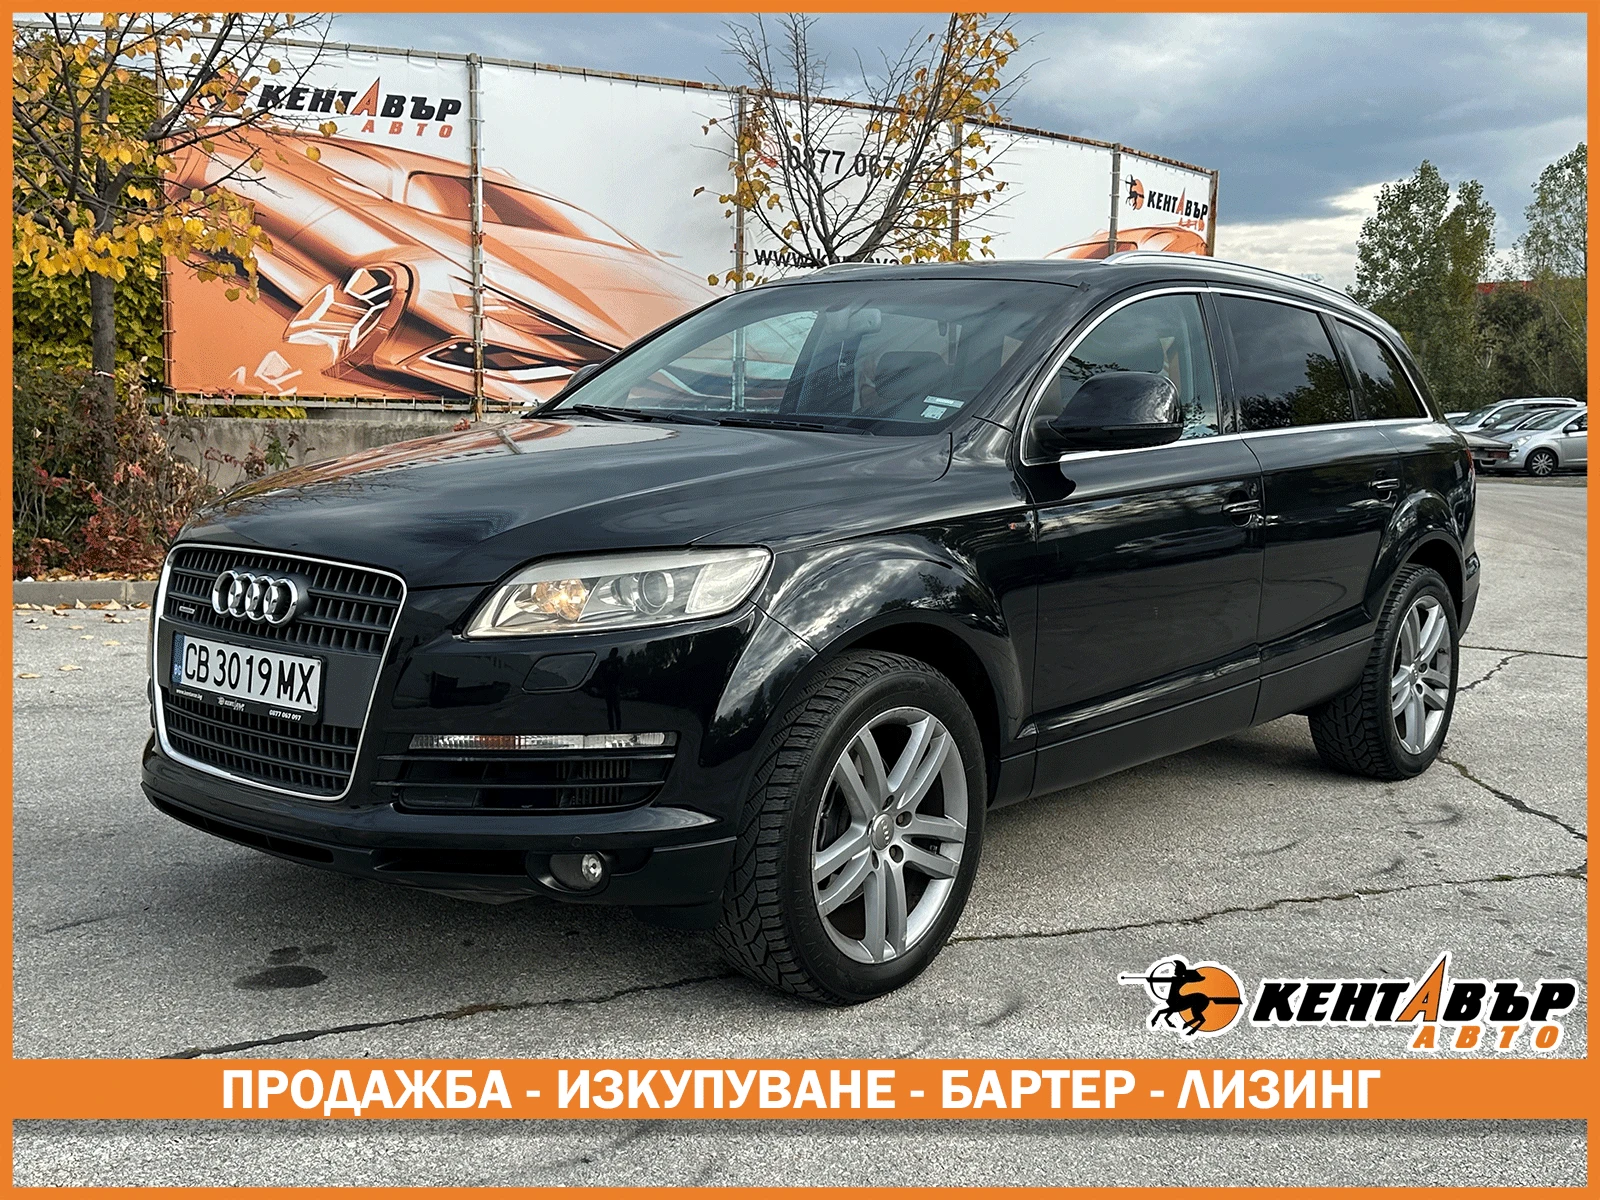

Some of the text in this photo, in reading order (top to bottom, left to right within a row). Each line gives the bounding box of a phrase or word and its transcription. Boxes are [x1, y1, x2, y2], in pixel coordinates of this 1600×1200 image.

[257, 77, 462, 122] КЕНТАВЪР
[361, 119, 453, 138] АВТО
[1147, 187, 1209, 220] КЕНТАВЪР
[213, 649, 272, 696] 3019
